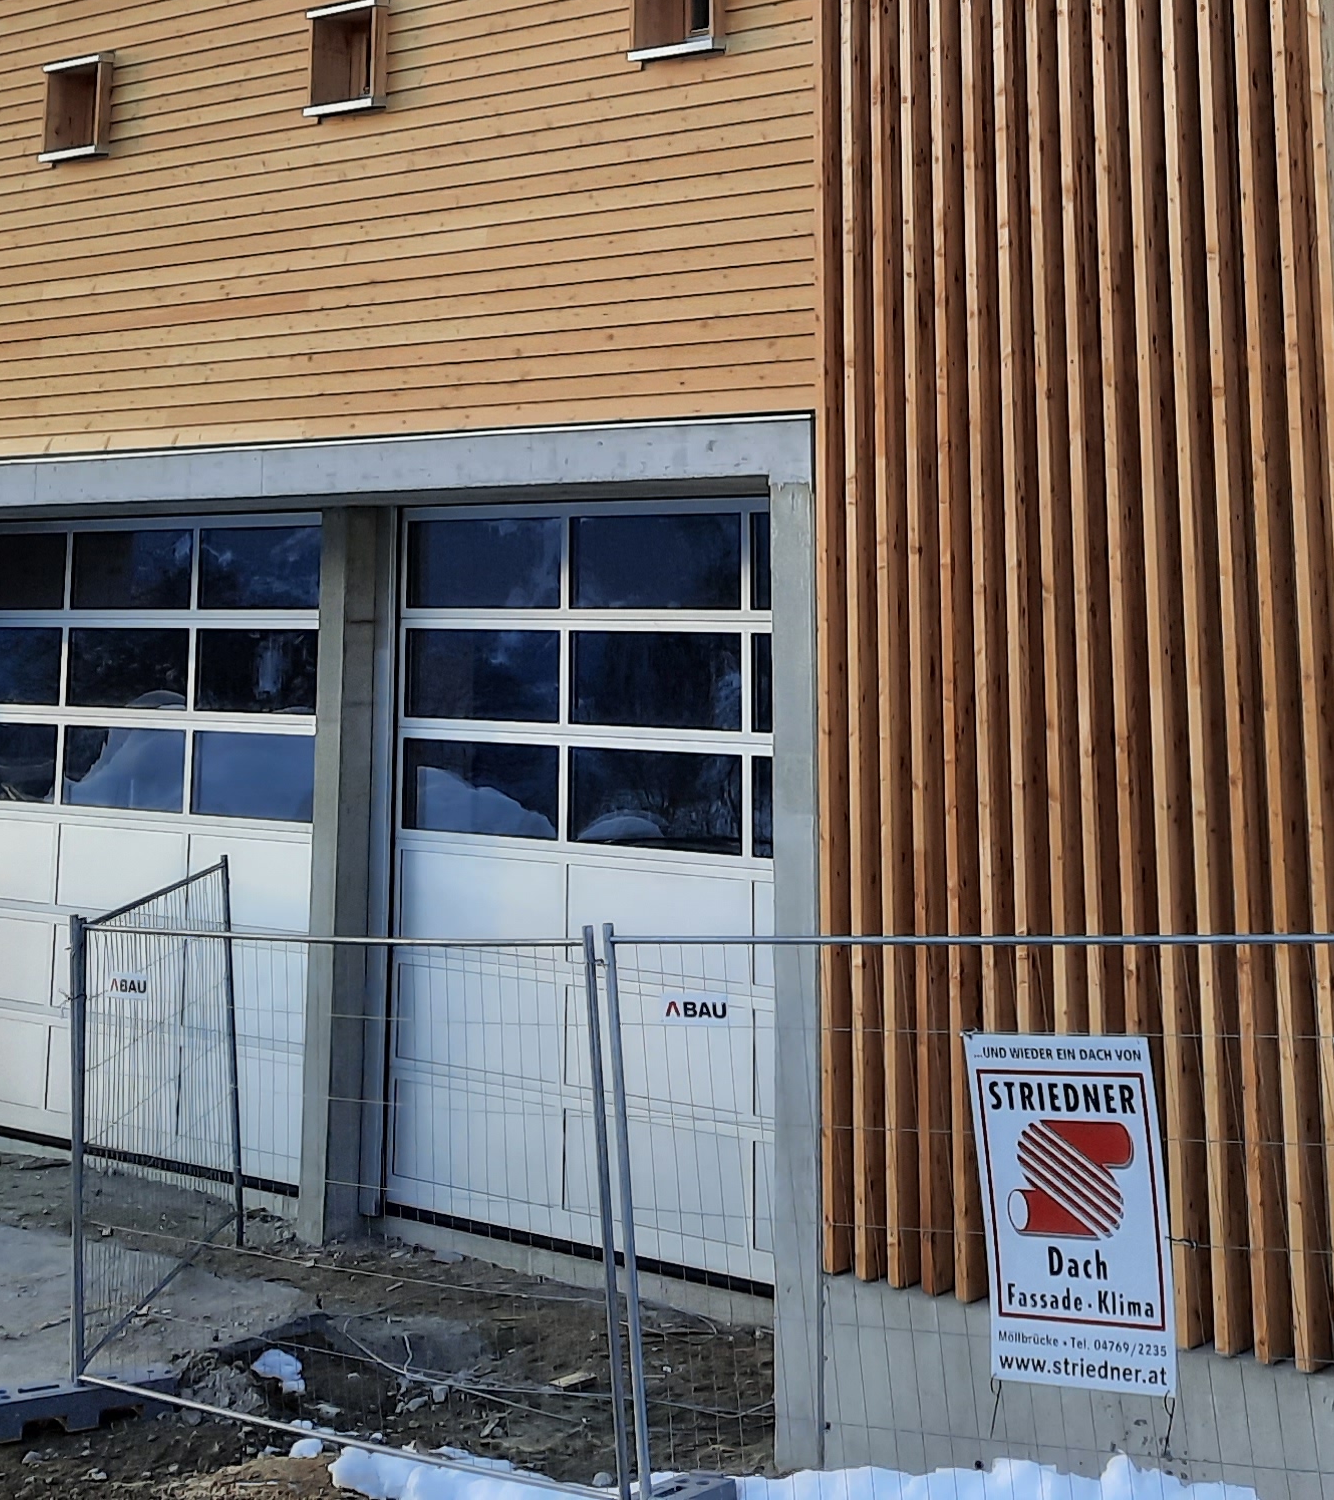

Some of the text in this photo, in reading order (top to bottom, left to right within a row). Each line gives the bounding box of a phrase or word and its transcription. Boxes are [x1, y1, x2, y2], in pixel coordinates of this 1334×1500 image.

[1009, 1047, 1053, 1061] WIEDER
[1057, 1048, 1076, 1061] EIN
[1080, 1049, 1112, 1061] DACH
[1117, 1049, 1142, 1062] VON
[988, 1080, 1136, 1114] STRIEDNER
[1047, 1246, 1108, 1280] Dach
[1007, 1283, 1155, 1318] Fassade Klima
[998, 1330, 1167, 1358] Möllbrücke Tel. 04769/2235
[999, 1355, 1167, 1386] www.striedner.at
